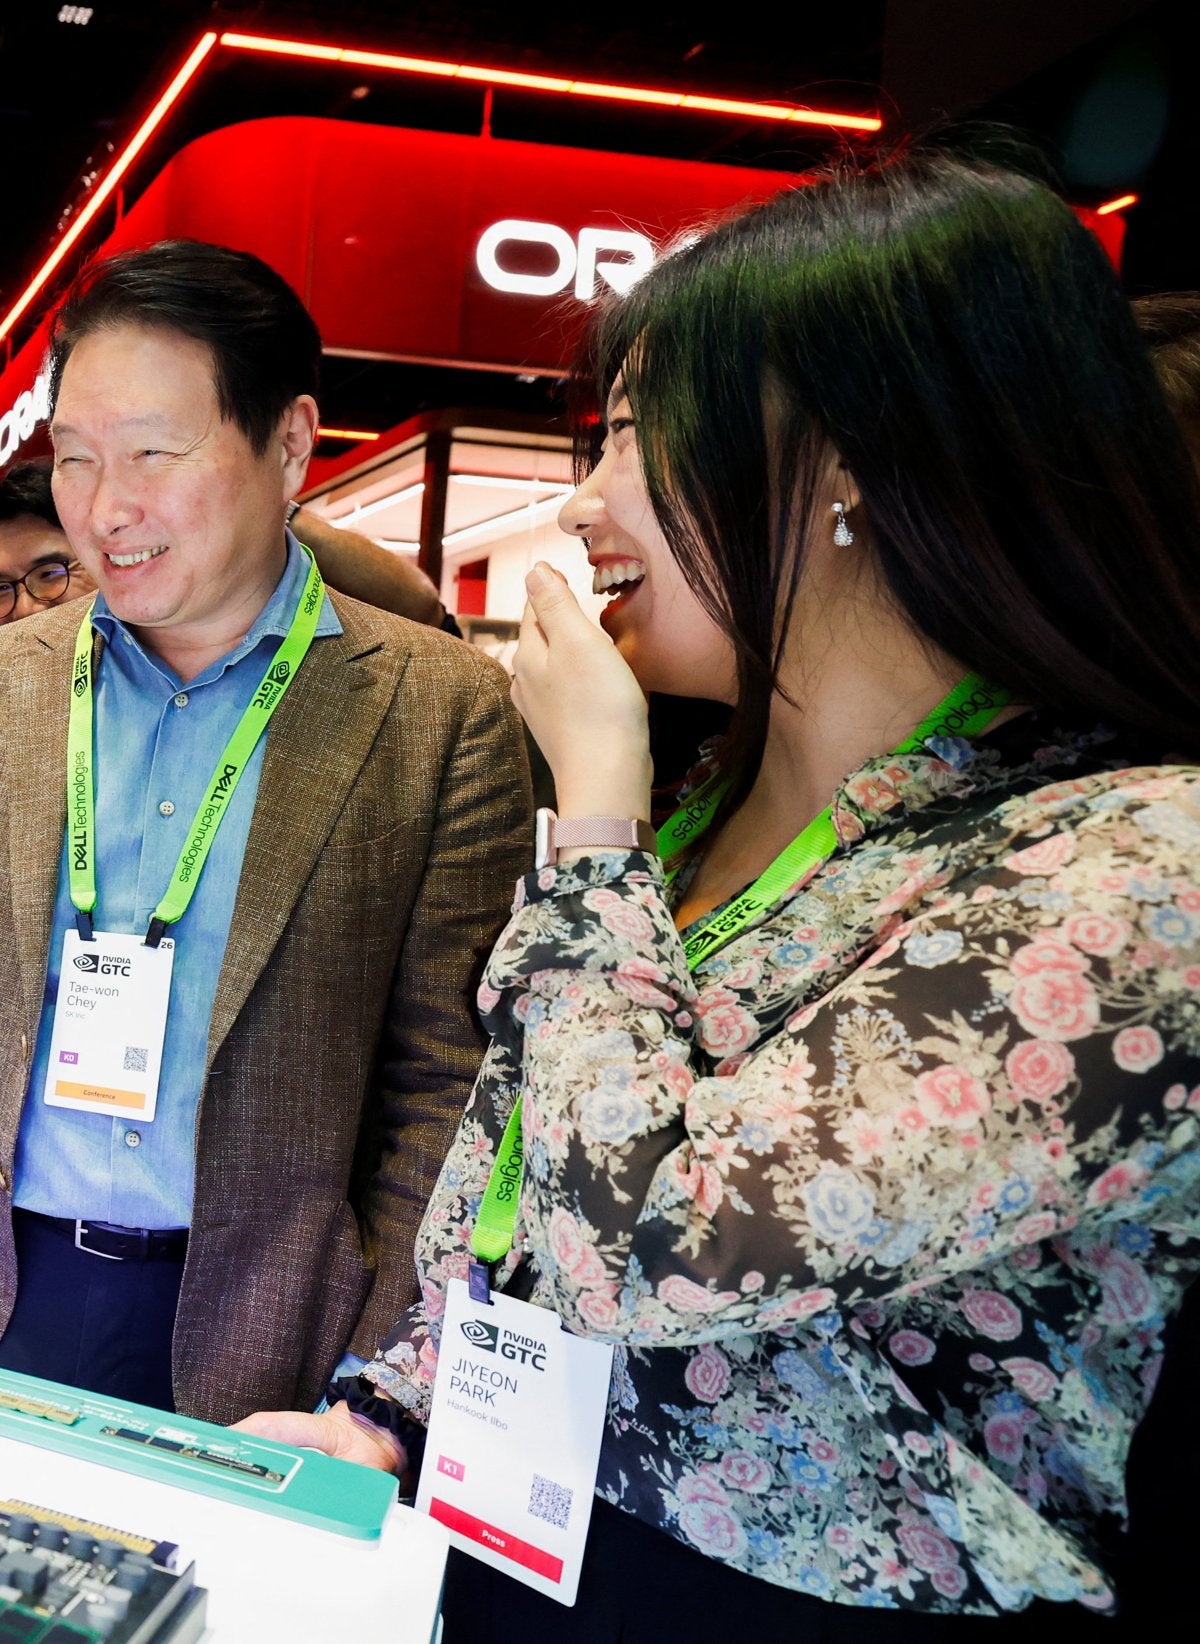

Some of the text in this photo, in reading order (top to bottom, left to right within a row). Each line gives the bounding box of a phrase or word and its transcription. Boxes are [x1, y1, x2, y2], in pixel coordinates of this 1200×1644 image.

[80, 651, 88, 675] GTC
[253, 682, 274, 708] GTC
[74, 751, 89, 870] DELL Technologies
[179, 764, 237, 883] DELL Technologies
[719, 900, 763, 932] GTC
[101, 964, 131, 977] GTC
[69, 981, 119, 997] Tae-won
[67, 995, 97, 1010] Chey
[83, 1089, 116, 1100] Conference
[501, 1343, 547, 1372] GTC
[452, 1358, 518, 1394] JIYEON
[450, 1375, 496, 1407] PARK
[446, 1398, 508, 1430] Hankook Ilbo
[443, 1460, 458, 1475] K1
[482, 1529, 506, 1548] Press
